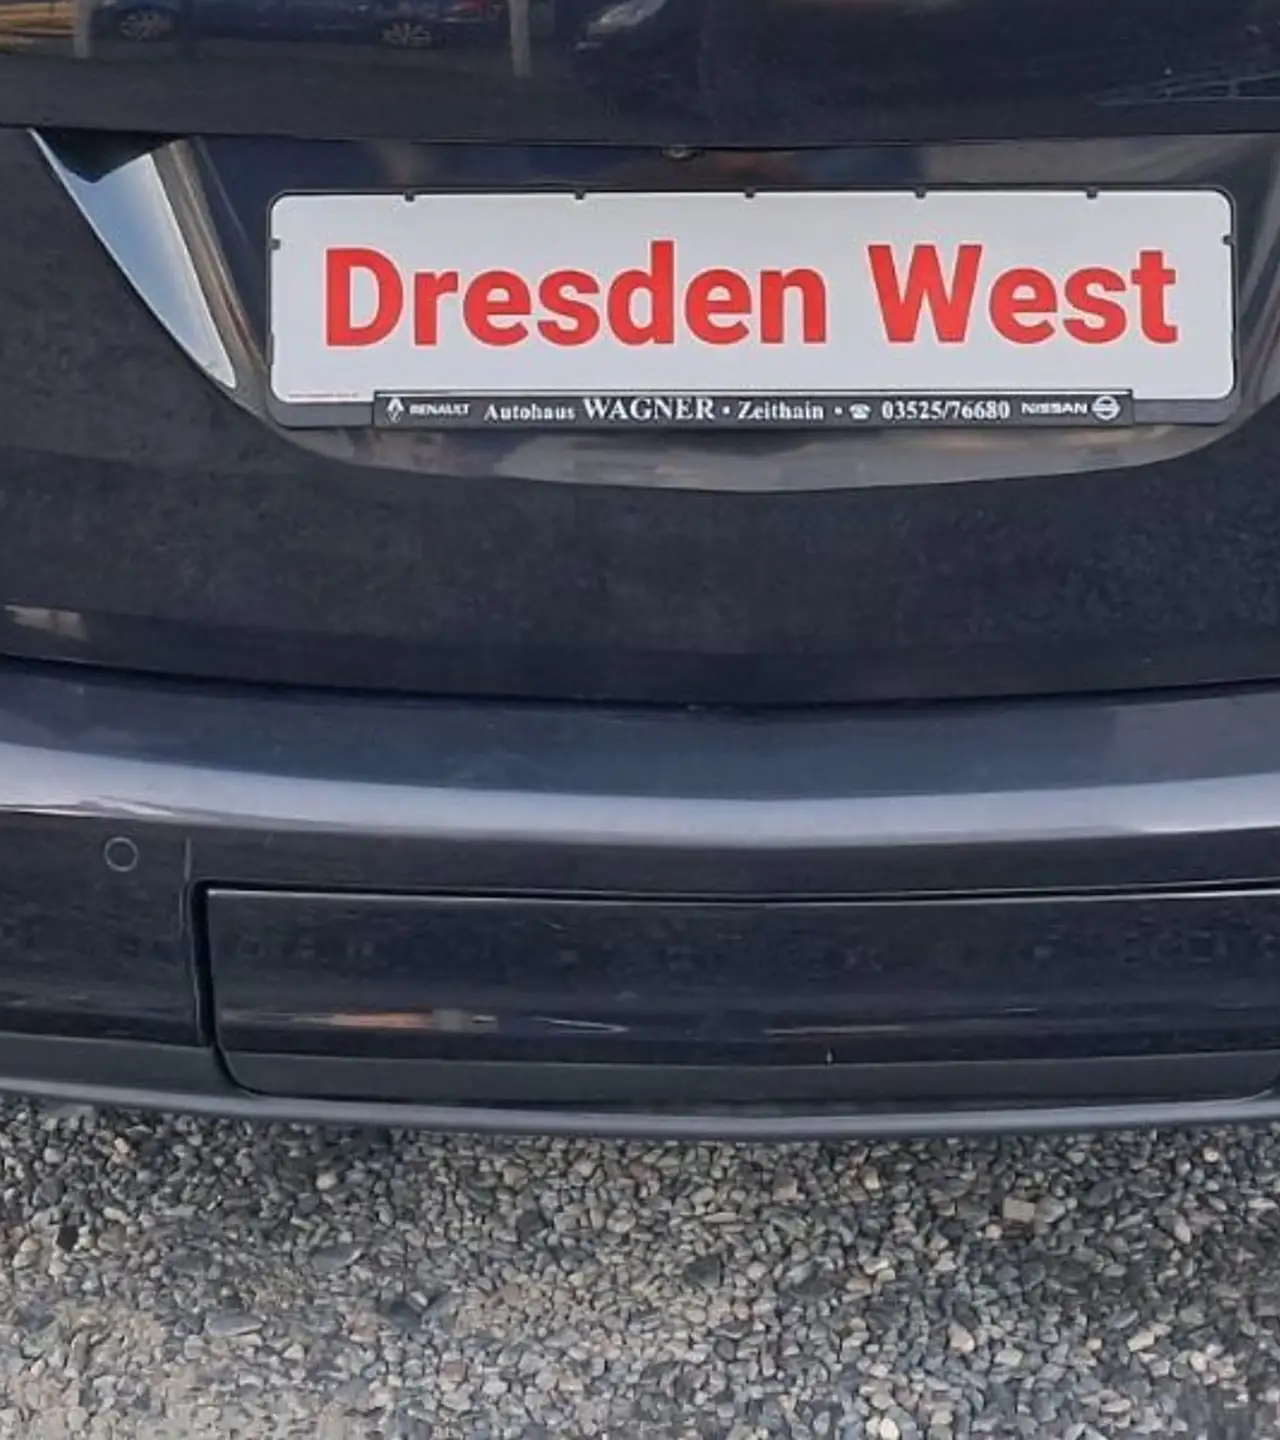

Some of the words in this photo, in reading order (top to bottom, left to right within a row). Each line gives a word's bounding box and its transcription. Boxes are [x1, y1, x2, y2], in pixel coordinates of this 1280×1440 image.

[324, 238, 828, 347] Dresden
[867, 242, 1179, 345] West
[408, 402, 471, 417] RENAULT
[483, 402, 576, 422] Autohaus
[581, 397, 715, 422] WAGNER
[736, 400, 824, 421] Zeithain
[880, 399, 1011, 422] 03525/76680
[1021, 401, 1088, 416] NISSAN
